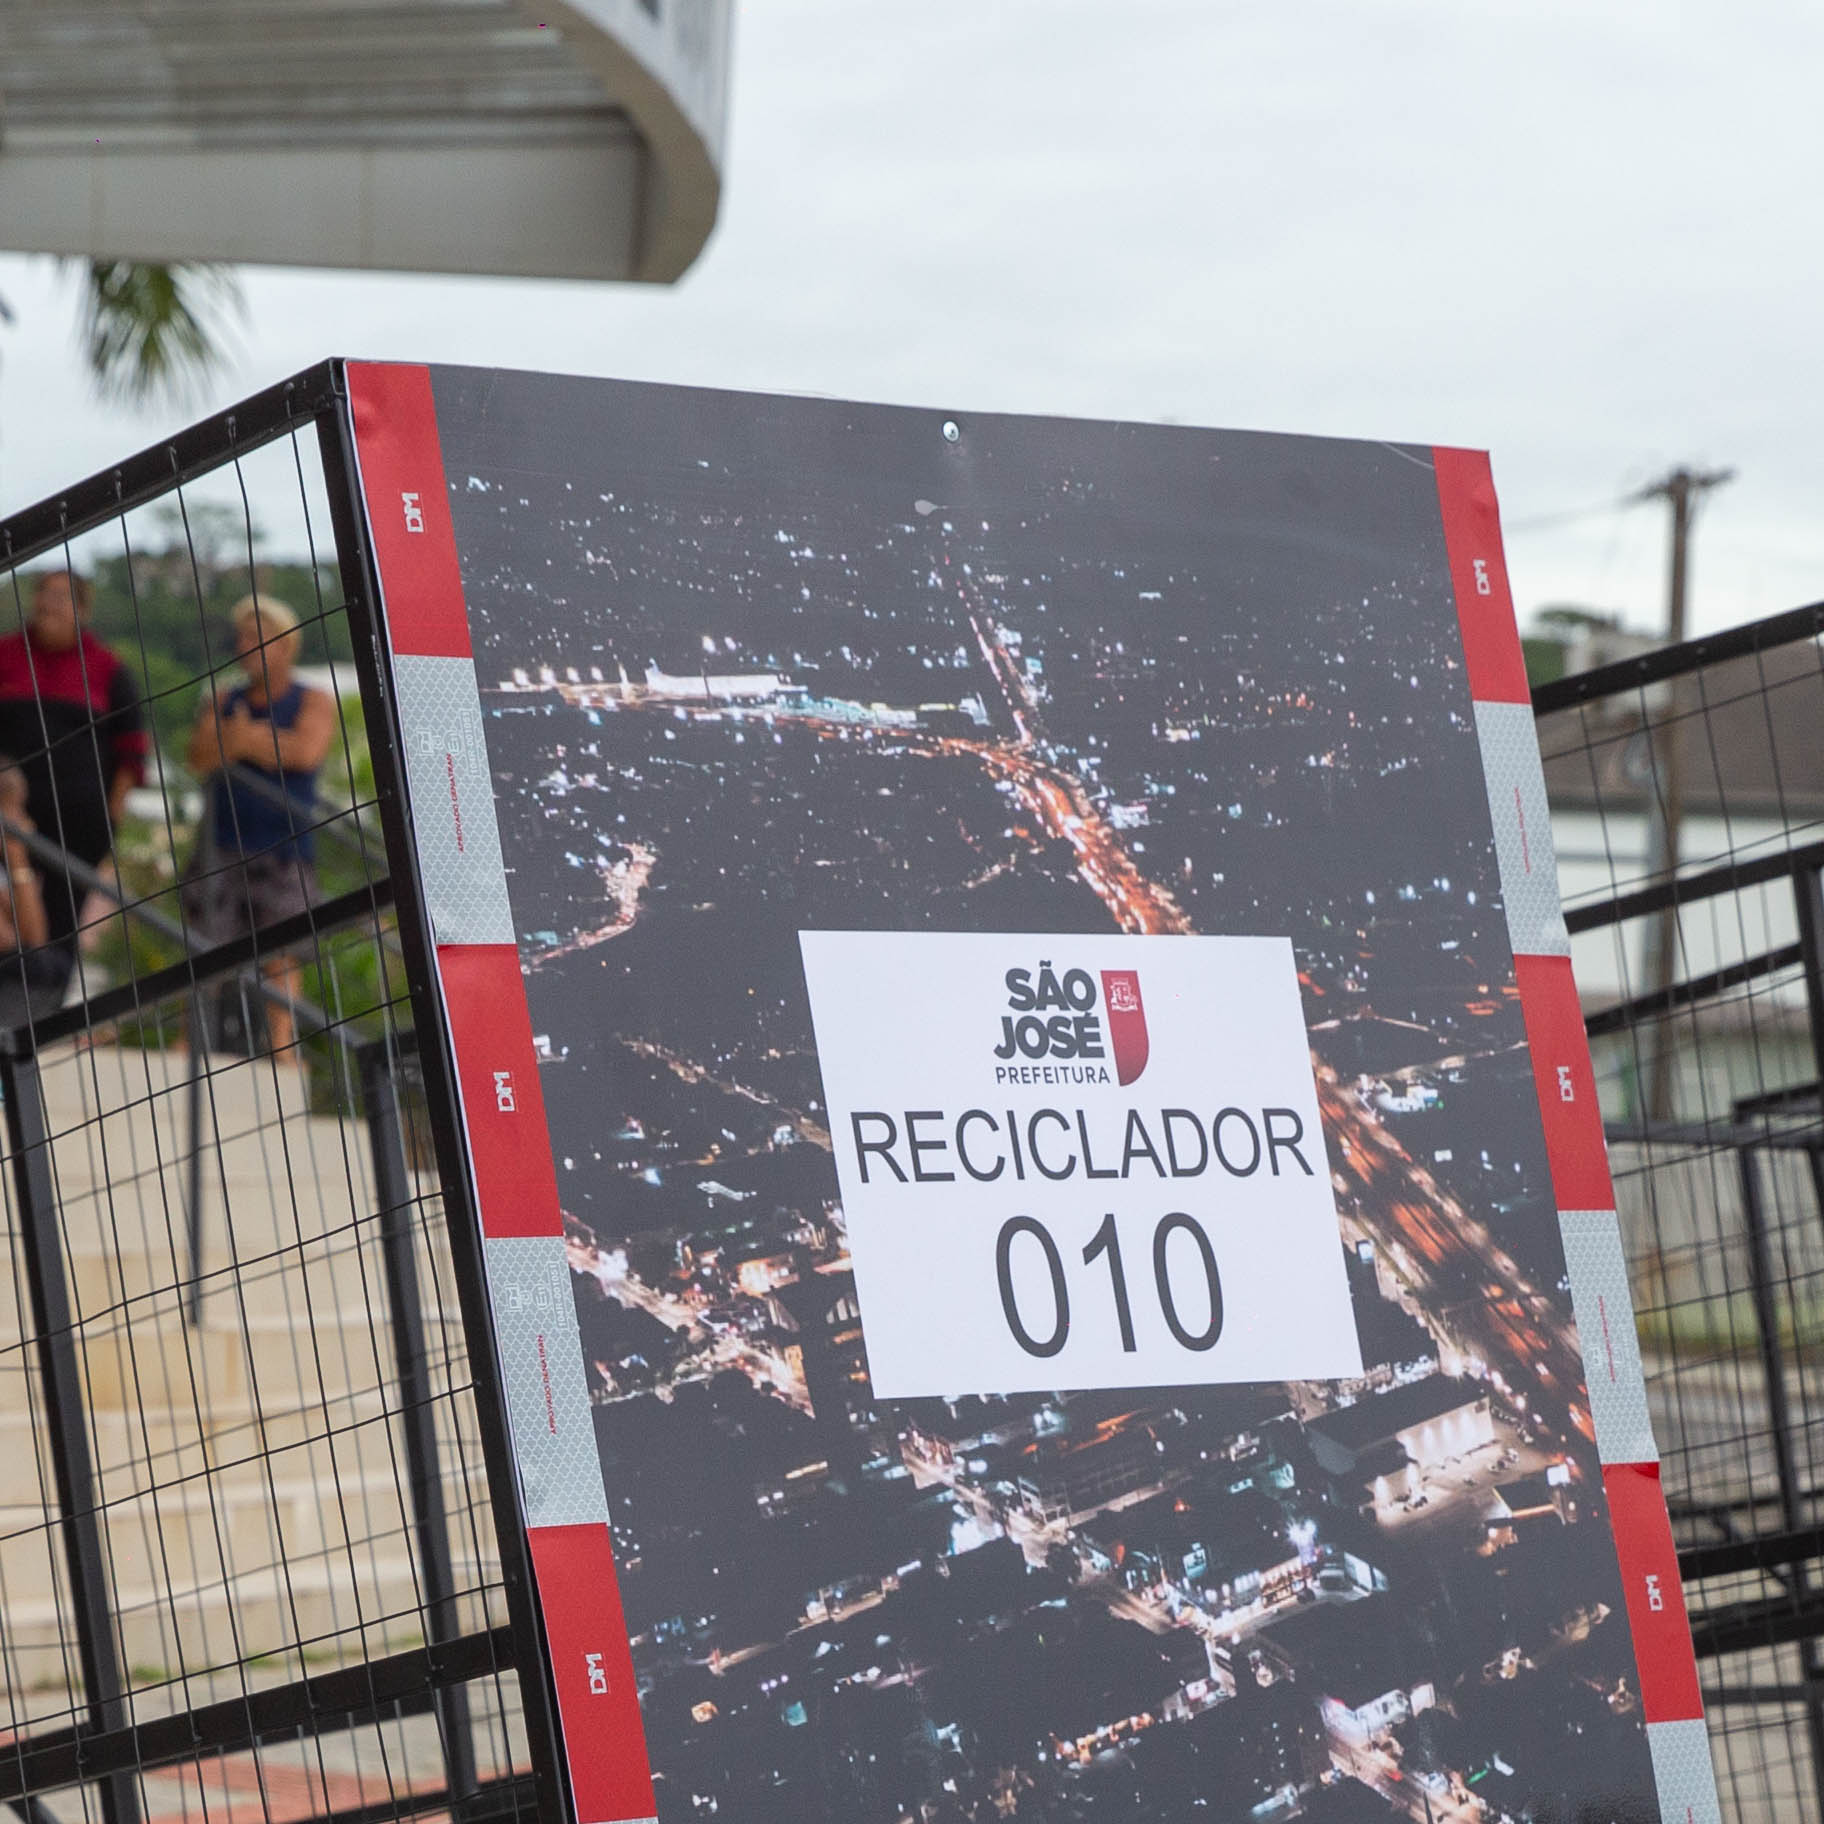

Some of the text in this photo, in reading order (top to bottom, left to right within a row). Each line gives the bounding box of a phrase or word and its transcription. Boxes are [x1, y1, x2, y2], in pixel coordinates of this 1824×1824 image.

[402, 493, 423, 532] DM
[1474, 560, 1490, 594] DM
[1006, 960, 1096, 1012] SÃO
[994, 1012, 1105, 1059] JOSÉ
[494, 1072, 514, 1111] DM
[996, 1067, 1110, 1083] PREFEITURA
[1557, 1067, 1573, 1101] DM
[851, 1108, 1314, 1183] RECICLADOR
[996, 1213, 1223, 1358] 010
[1646, 1575, 1662, 1610] DM
[586, 1654, 607, 1694] DM
